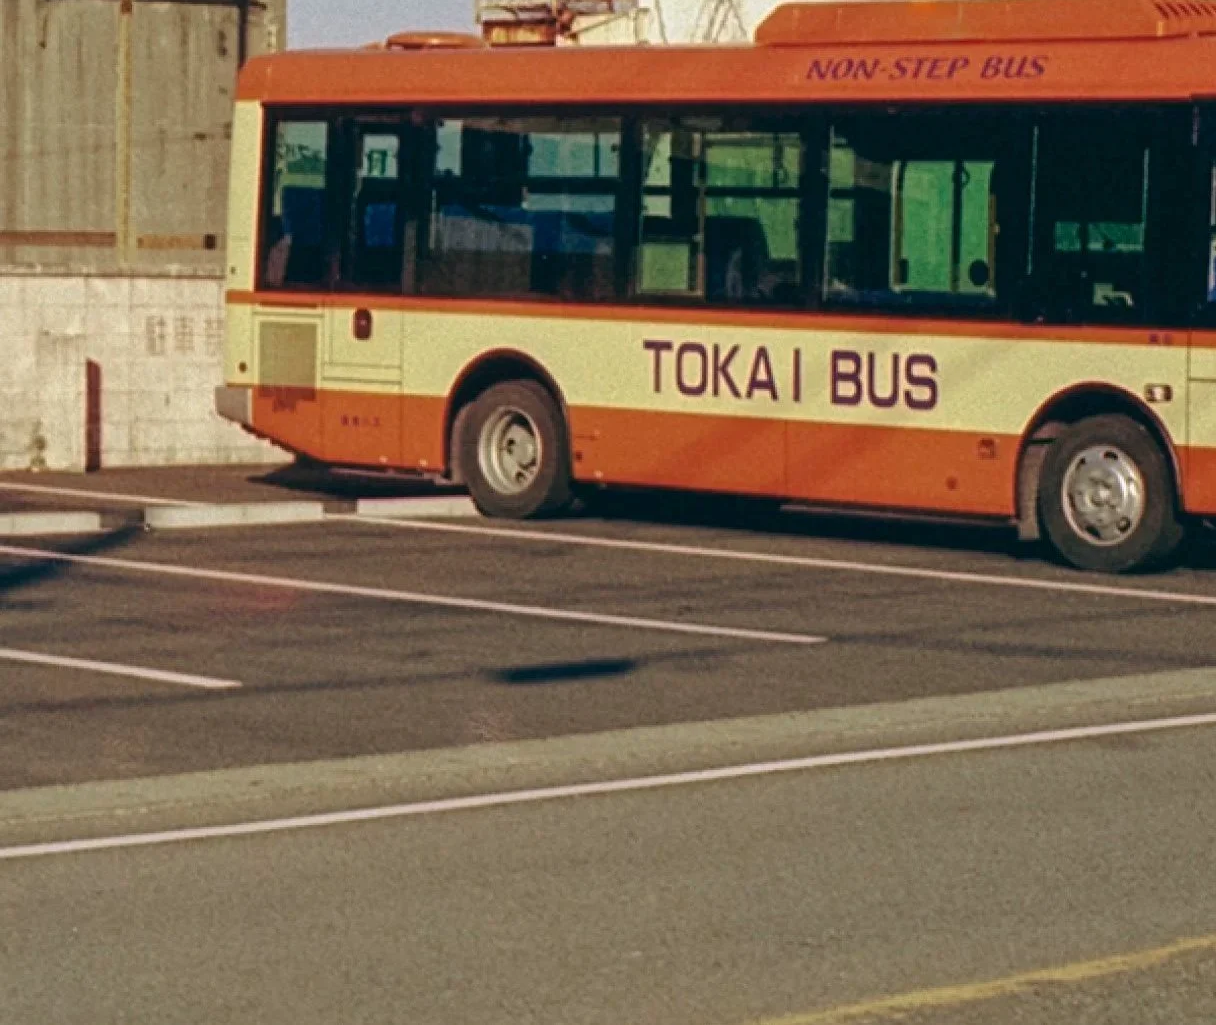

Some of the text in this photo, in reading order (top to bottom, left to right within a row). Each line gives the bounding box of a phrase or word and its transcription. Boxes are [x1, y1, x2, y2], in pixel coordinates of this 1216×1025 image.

[806, 54, 1048, 81] NON-STEP BUS
[643, 339, 938, 411] TOKAI BUS
